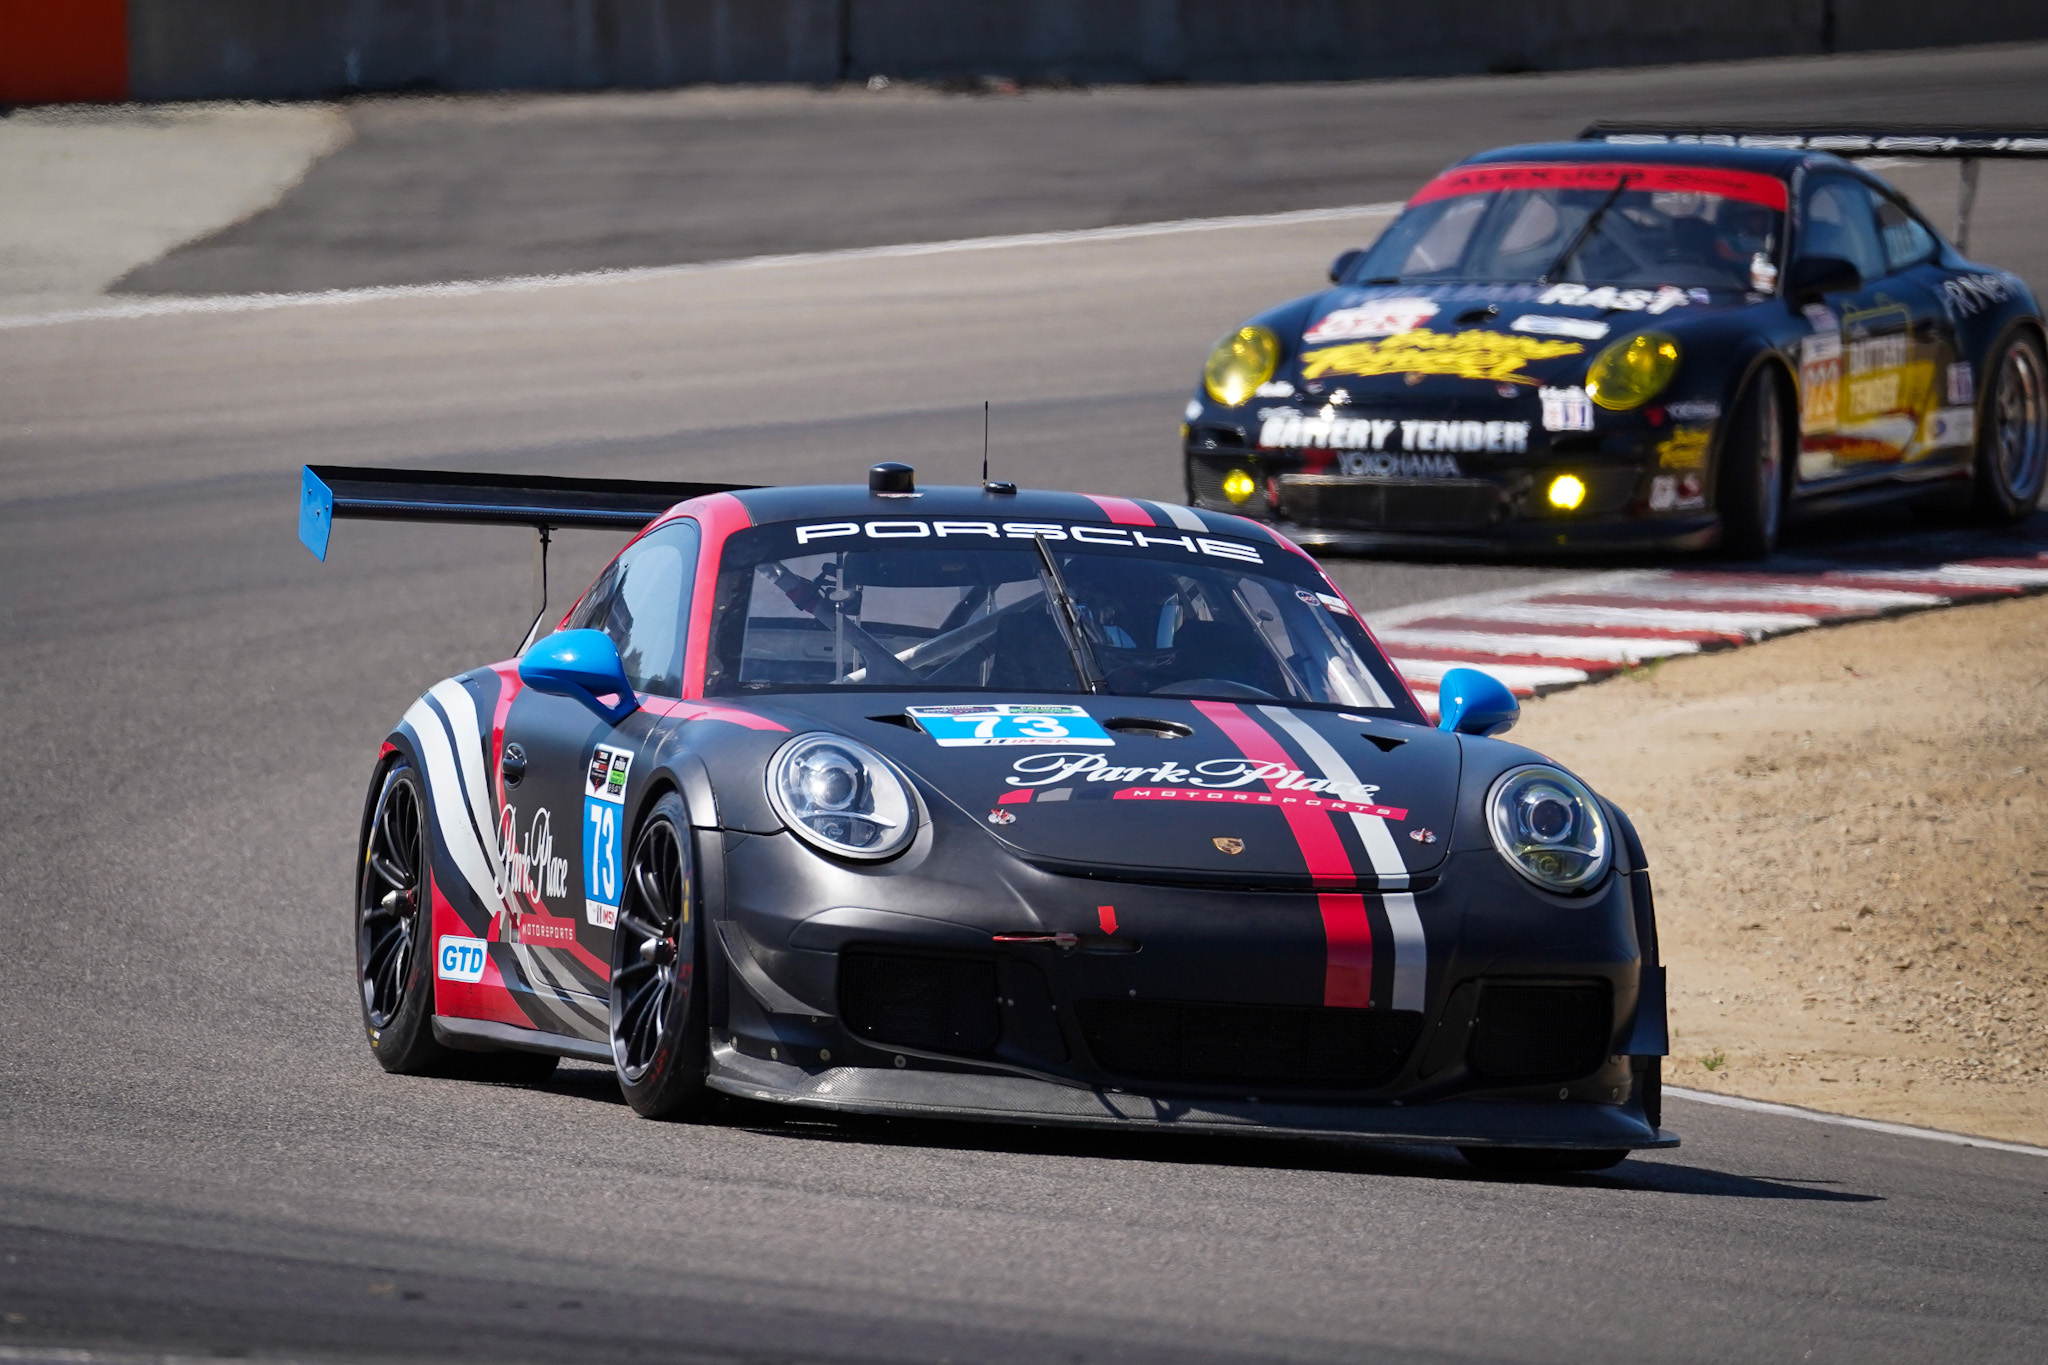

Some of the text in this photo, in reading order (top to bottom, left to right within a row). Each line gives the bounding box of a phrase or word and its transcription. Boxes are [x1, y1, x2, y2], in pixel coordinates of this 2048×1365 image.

[1400, 419, 1531, 453] TENDER
[1337, 451, 1461, 477] YOKOHAMA
[795, 521, 1264, 564] PORSCHE
[952, 716, 1069, 738] 73
[1006, 752, 1380, 798] Park Place
[1133, 790, 1391, 815] MOTORSPORTS
[494, 803, 568, 904] Park Place
[590, 804, 615, 901] 73
[522, 923, 574, 941] MOTORSPORTS
[442, 945, 483, 974] GTD
